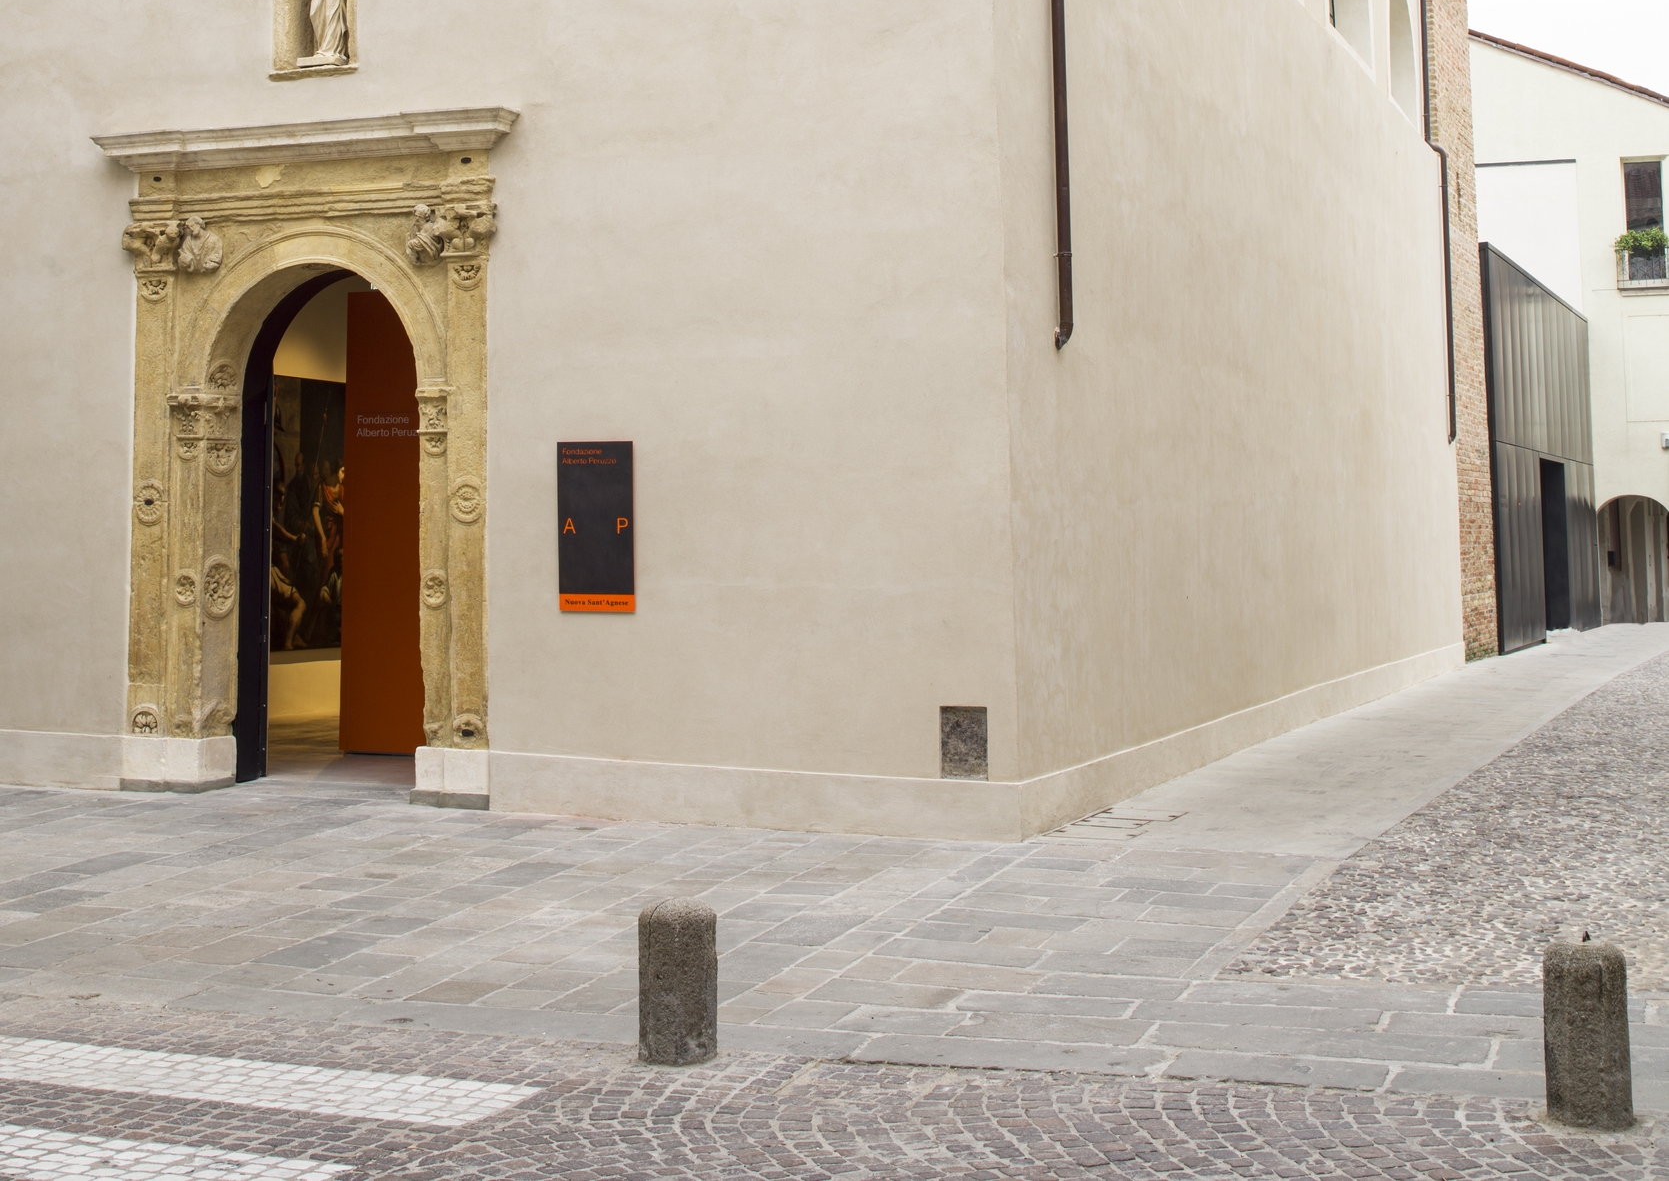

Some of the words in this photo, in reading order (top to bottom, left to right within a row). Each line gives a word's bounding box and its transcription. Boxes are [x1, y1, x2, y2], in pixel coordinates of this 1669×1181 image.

[357, 415, 409, 424] Fondazione
[356, 427, 390, 437] Alberto
[391, 427, 420, 437] Peruz
[563, 517, 576, 534] A
[617, 517, 629, 534] P
